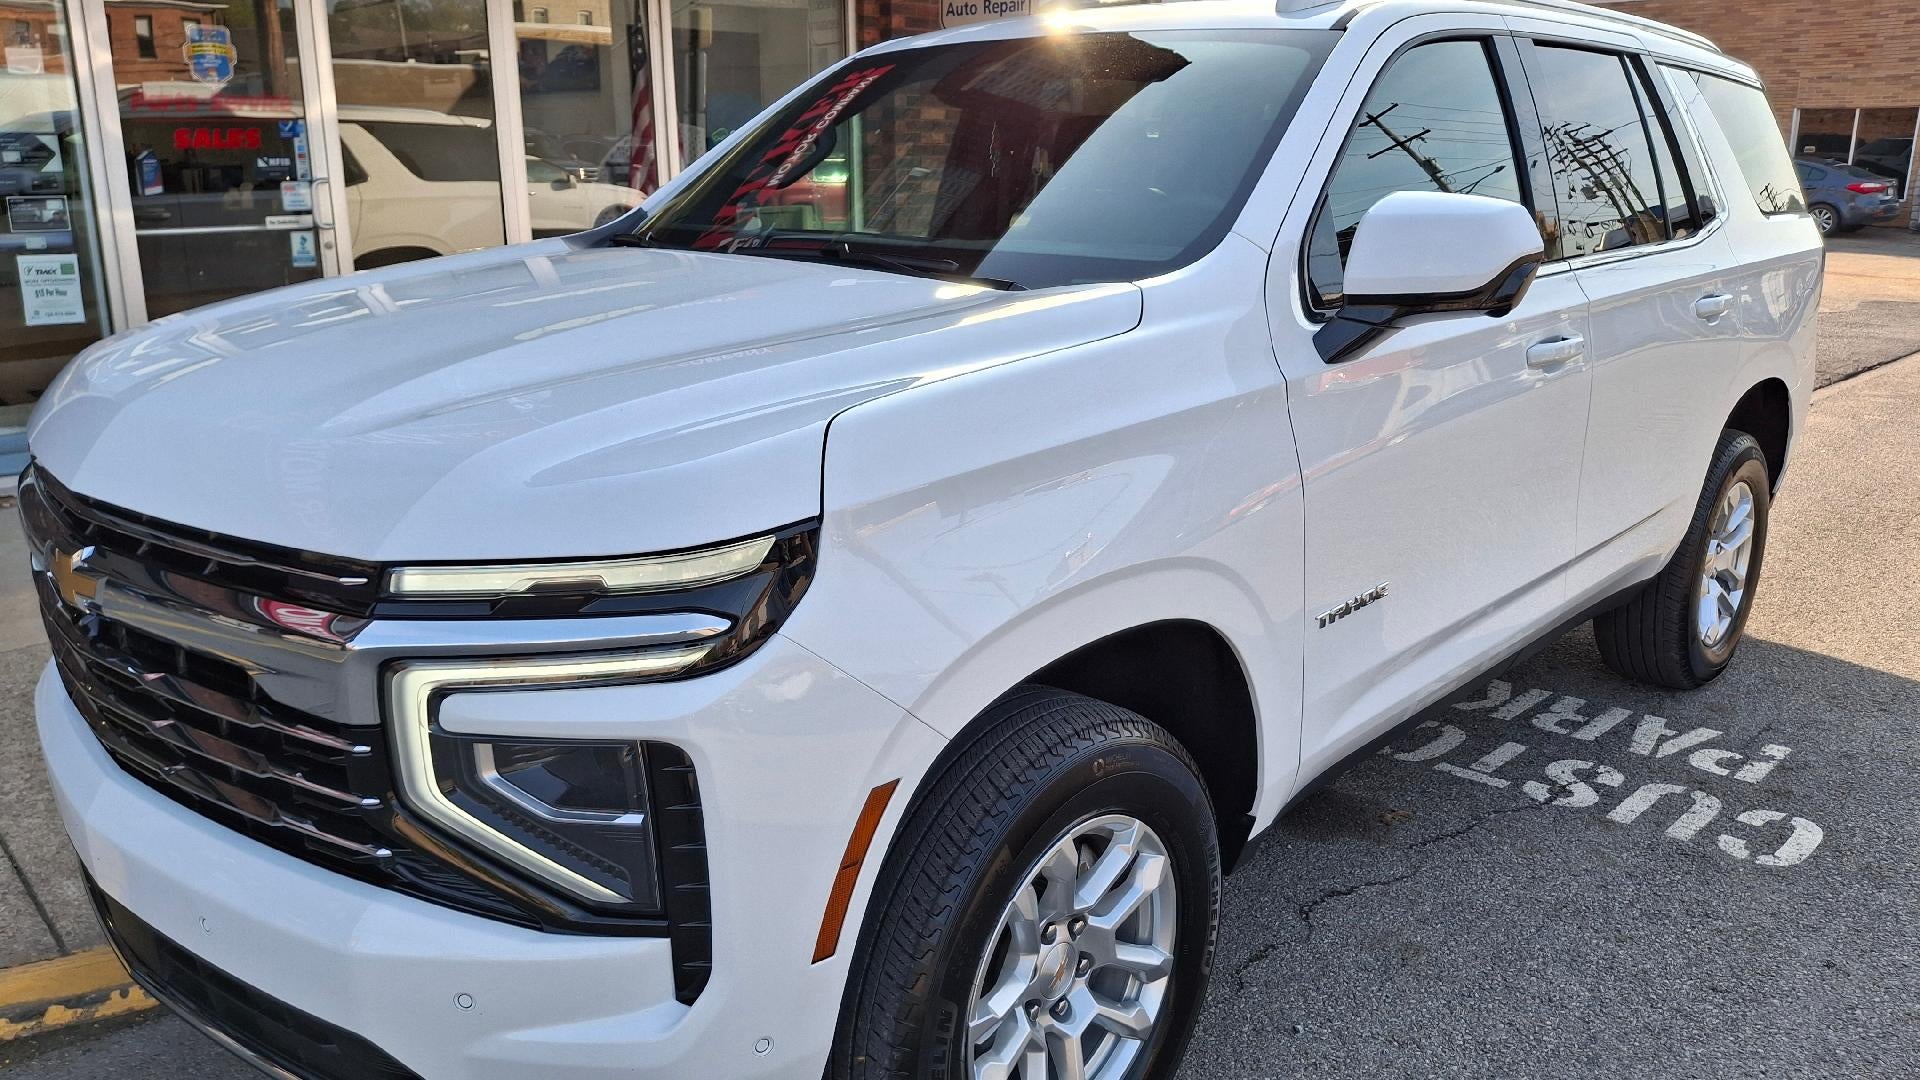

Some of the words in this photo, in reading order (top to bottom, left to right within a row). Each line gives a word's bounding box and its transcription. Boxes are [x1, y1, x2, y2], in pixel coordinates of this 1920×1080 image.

[946, 2, 978, 17] Auto
[983, 0, 1024, 17] Repair
[173, 127, 262, 149] SALES
[1315, 581, 1390, 629] TAHOE
[1452, 680, 1792, 784] PARK
[1204, 842, 1220, 968] MICHELIN
